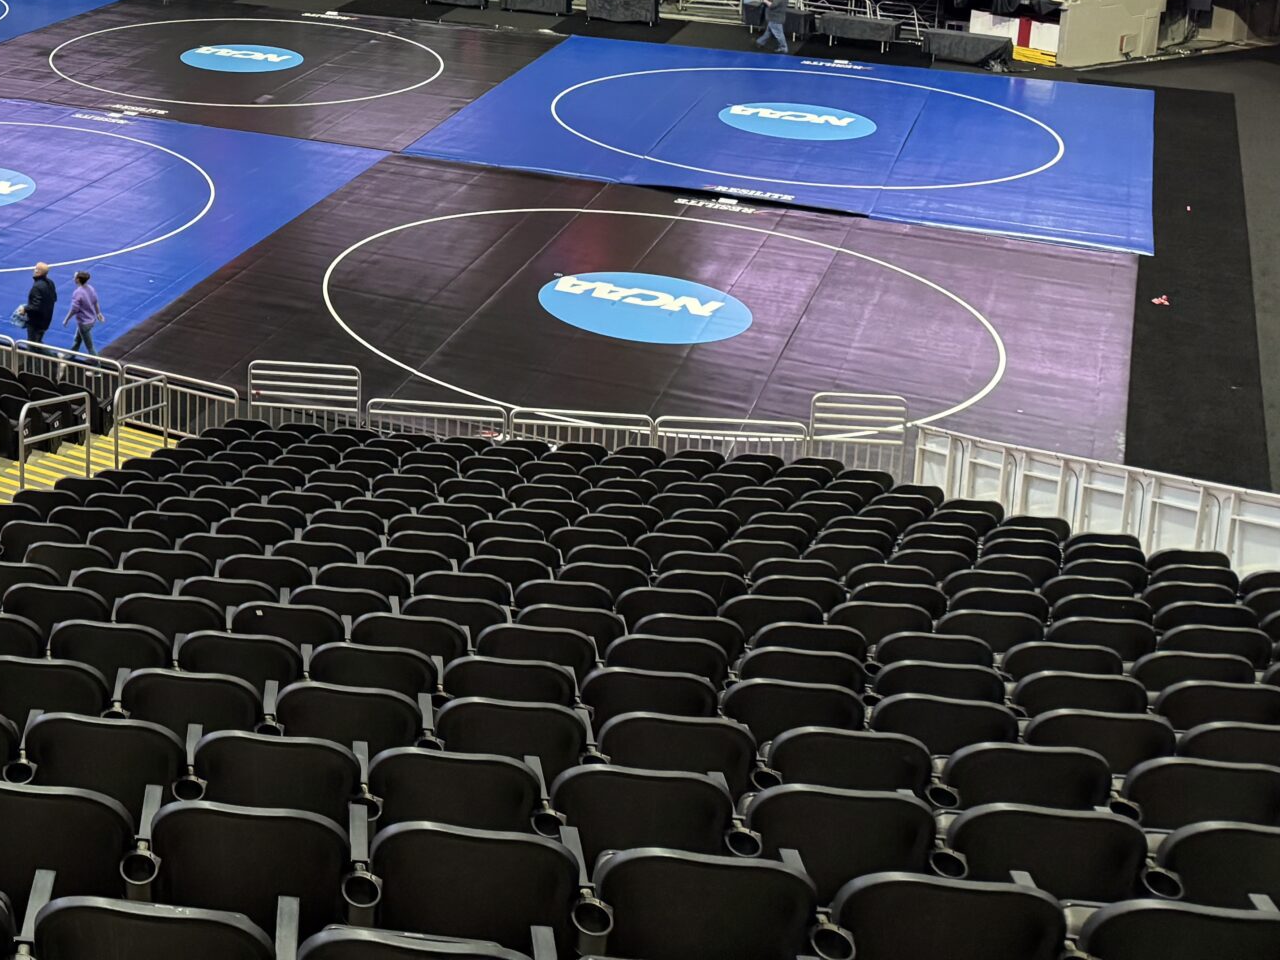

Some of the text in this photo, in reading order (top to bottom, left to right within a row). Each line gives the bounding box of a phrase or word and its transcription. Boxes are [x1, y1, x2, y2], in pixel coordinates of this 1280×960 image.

[194, 45, 293, 63] NCAA
[729, 105, 857, 127] NCAA
[715, 185, 796, 201] RESILITE
[554, 276, 725, 317] NCAA
